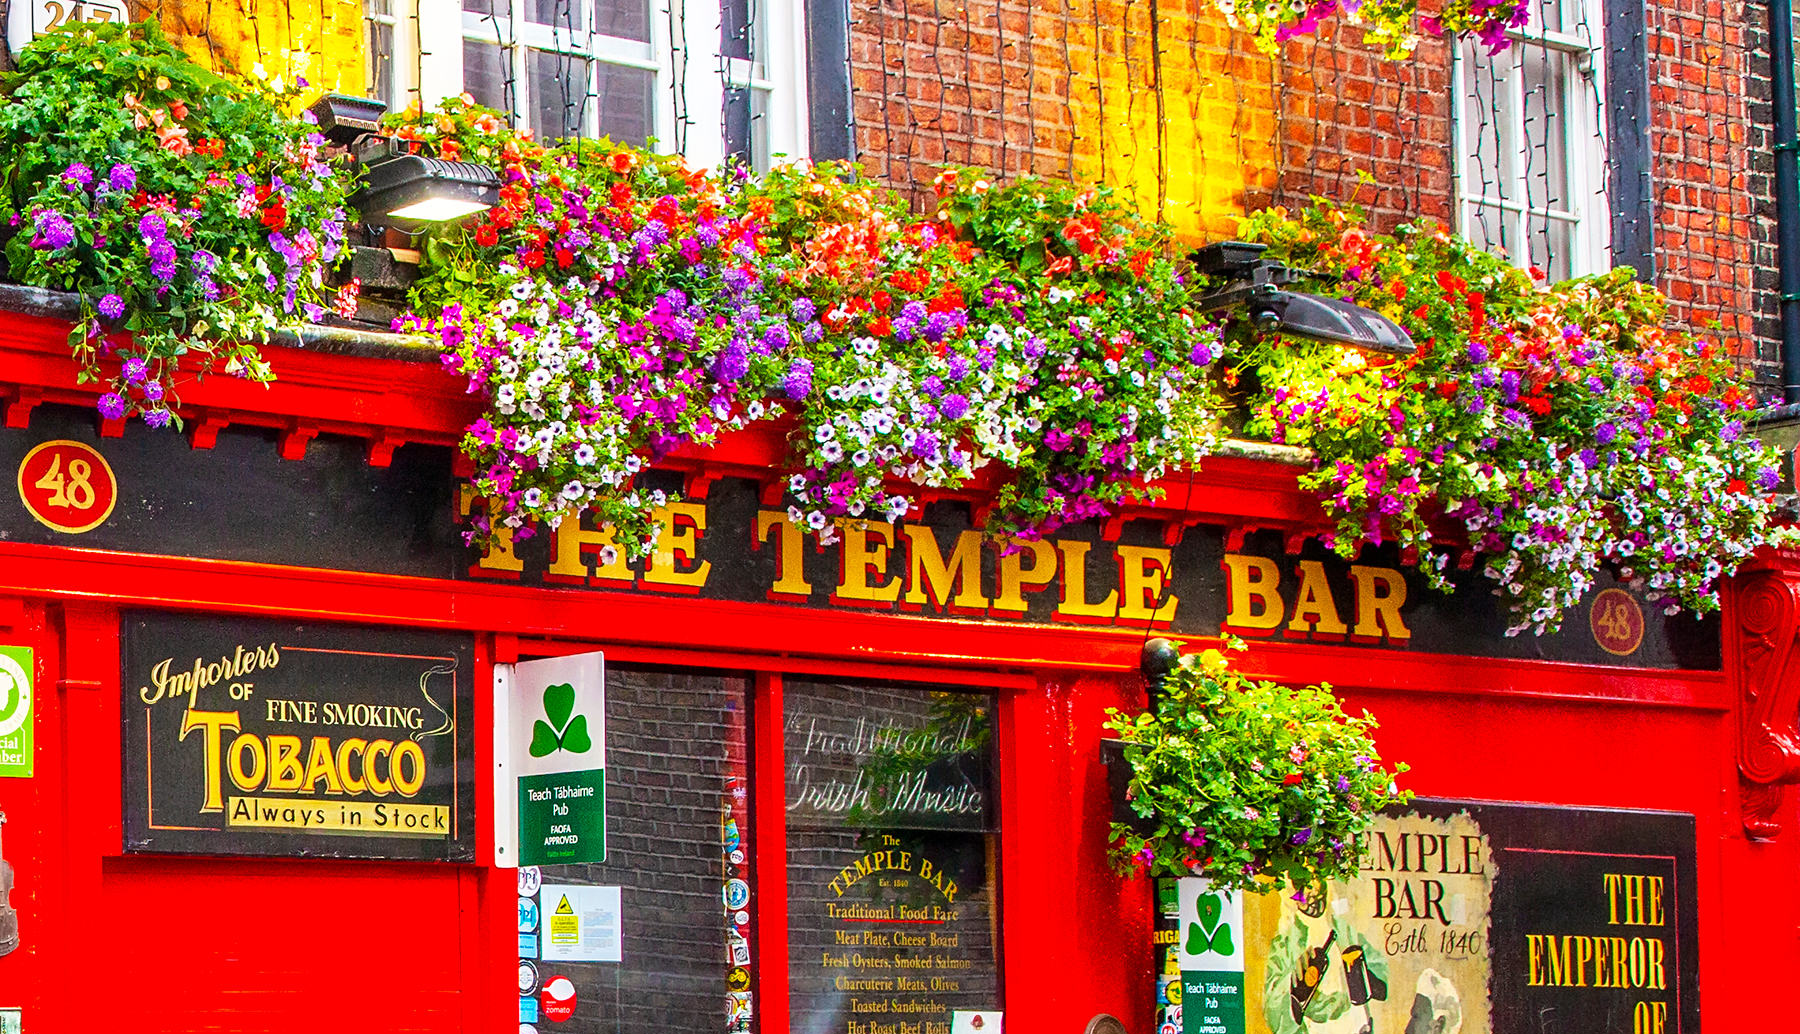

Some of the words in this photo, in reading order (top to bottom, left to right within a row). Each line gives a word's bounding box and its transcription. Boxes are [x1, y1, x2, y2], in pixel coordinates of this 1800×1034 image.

[33, 452, 96, 509] 48
[461, 483, 711, 592] THE
[756, 509, 1179, 624] TEMPLE
[1222, 552, 1411, 640] BAR
[1598, 600, 1631, 640] 48
[140, 642, 280, 709] Importers
[229, 682, 254, 701] OF
[266, 699, 317, 724] FINE
[322, 702, 424, 730] SMOKING
[785, 710, 973, 755] Traditional
[178, 708, 426, 814] TOBACCO
[528, 787, 551, 801] Teach
[784, 763, 869, 812] Irish
[887, 769, 982, 814] Music
[233, 798, 325, 827] Always
[341, 805, 362, 825] in
[374, 803, 445, 830] Stock
[553, 804, 569, 816] Pub
[544, 835, 578, 846] APPROVED
[882, 834, 900, 846] The
[1357, 830, 1485, 875] EMPLE
[828, 850, 912, 898] TEMPLE
[919, 857, 958, 904] BAR
[879, 878, 891, 887] Est.
[893, 878, 909, 888] 1840
[1372, 878, 1451, 926] BAR
[1604, 873, 1665, 926] THE
[826, 903, 894, 920] Traditional
[900, 905, 928, 920] Food
[933, 906, 959, 922] Fare
[835, 930, 859, 945] Meat
[864, 931, 891, 948] Plate,
[894, 931, 926, 947] Cheese
[930, 932, 958, 947] Board
[1439, 929, 1482, 956] 1840
[822, 953, 849, 968] Fresh
[852, 953, 891, 972] Oysters,
[895, 954, 932, 969] Smoked
[935, 954, 971, 969] Salmon
[1526, 934, 1667, 991] EMPEROR
[835, 976, 893, 991] Charcuterie
[896, 976, 927, 992] Meats,
[930, 976, 959, 991] Olives
[1185, 983, 1204, 994] Teach
[851, 998, 888, 1013] Toasted
[891, 998, 946, 1014] Sandwiches
[1205, 998, 1218, 1008] Pub
[848, 1021, 866, 1034] Hot
[1199, 1025, 1226, 1034] APPROVED
